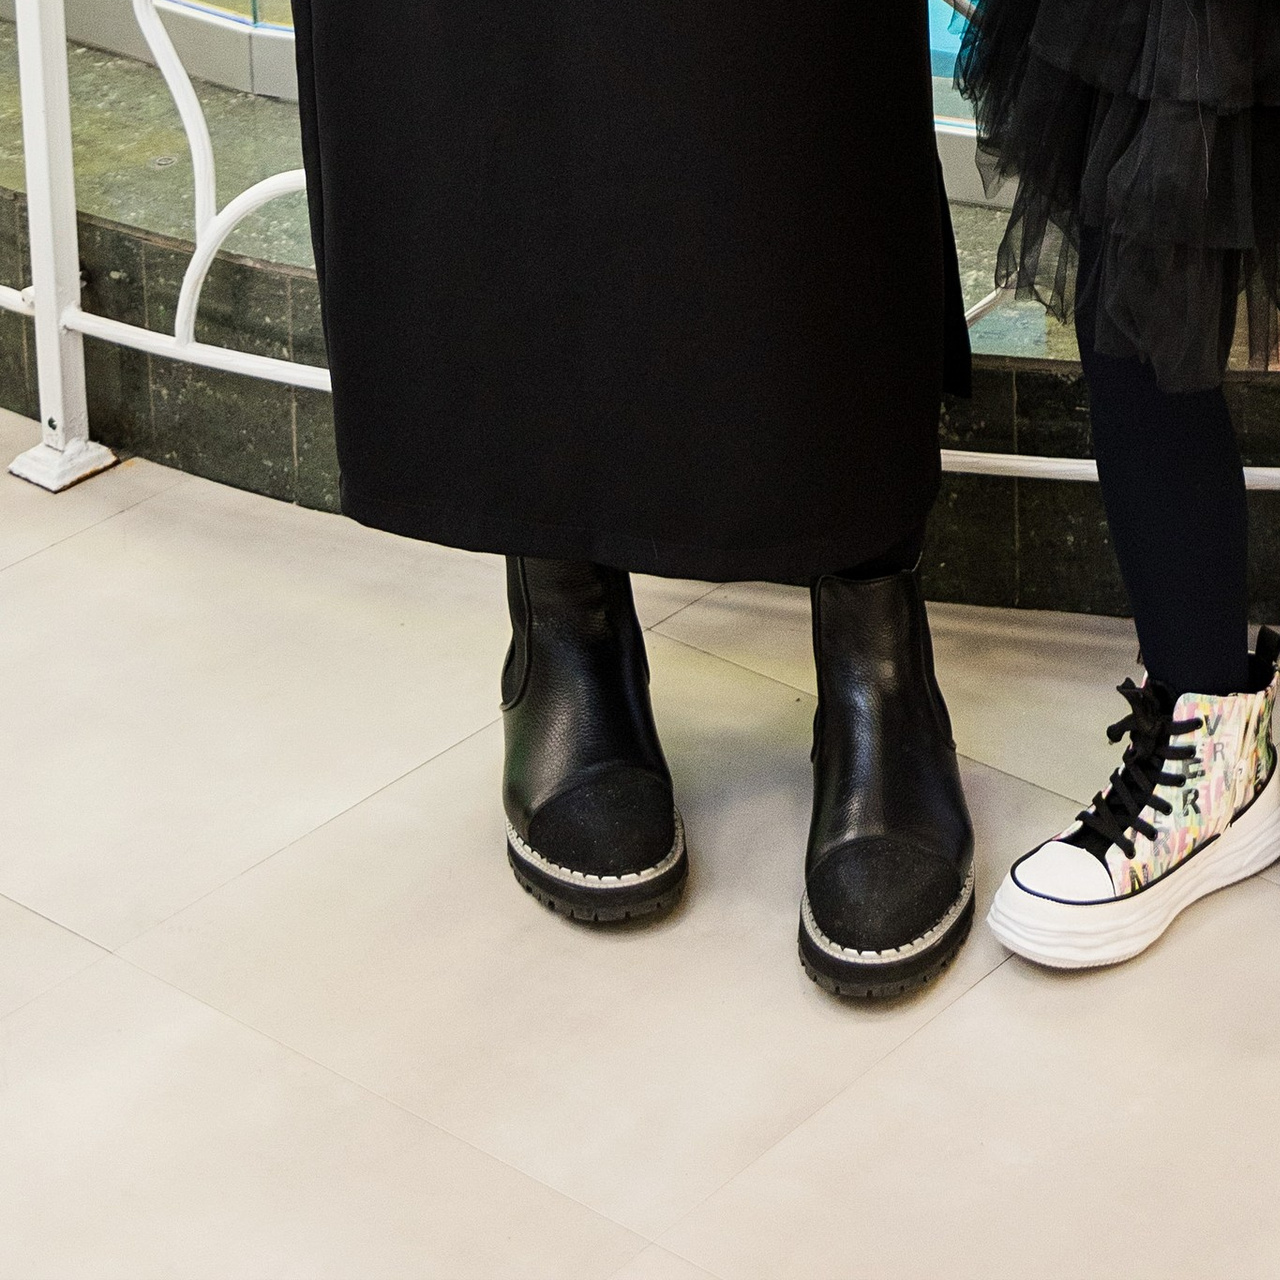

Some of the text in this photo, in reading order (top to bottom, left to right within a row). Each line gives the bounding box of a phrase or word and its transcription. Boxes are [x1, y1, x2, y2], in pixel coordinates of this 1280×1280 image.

[1203, 714, 1222, 736] V
[1213, 742, 1225, 762] R
[1182, 788, 1201, 817] R
